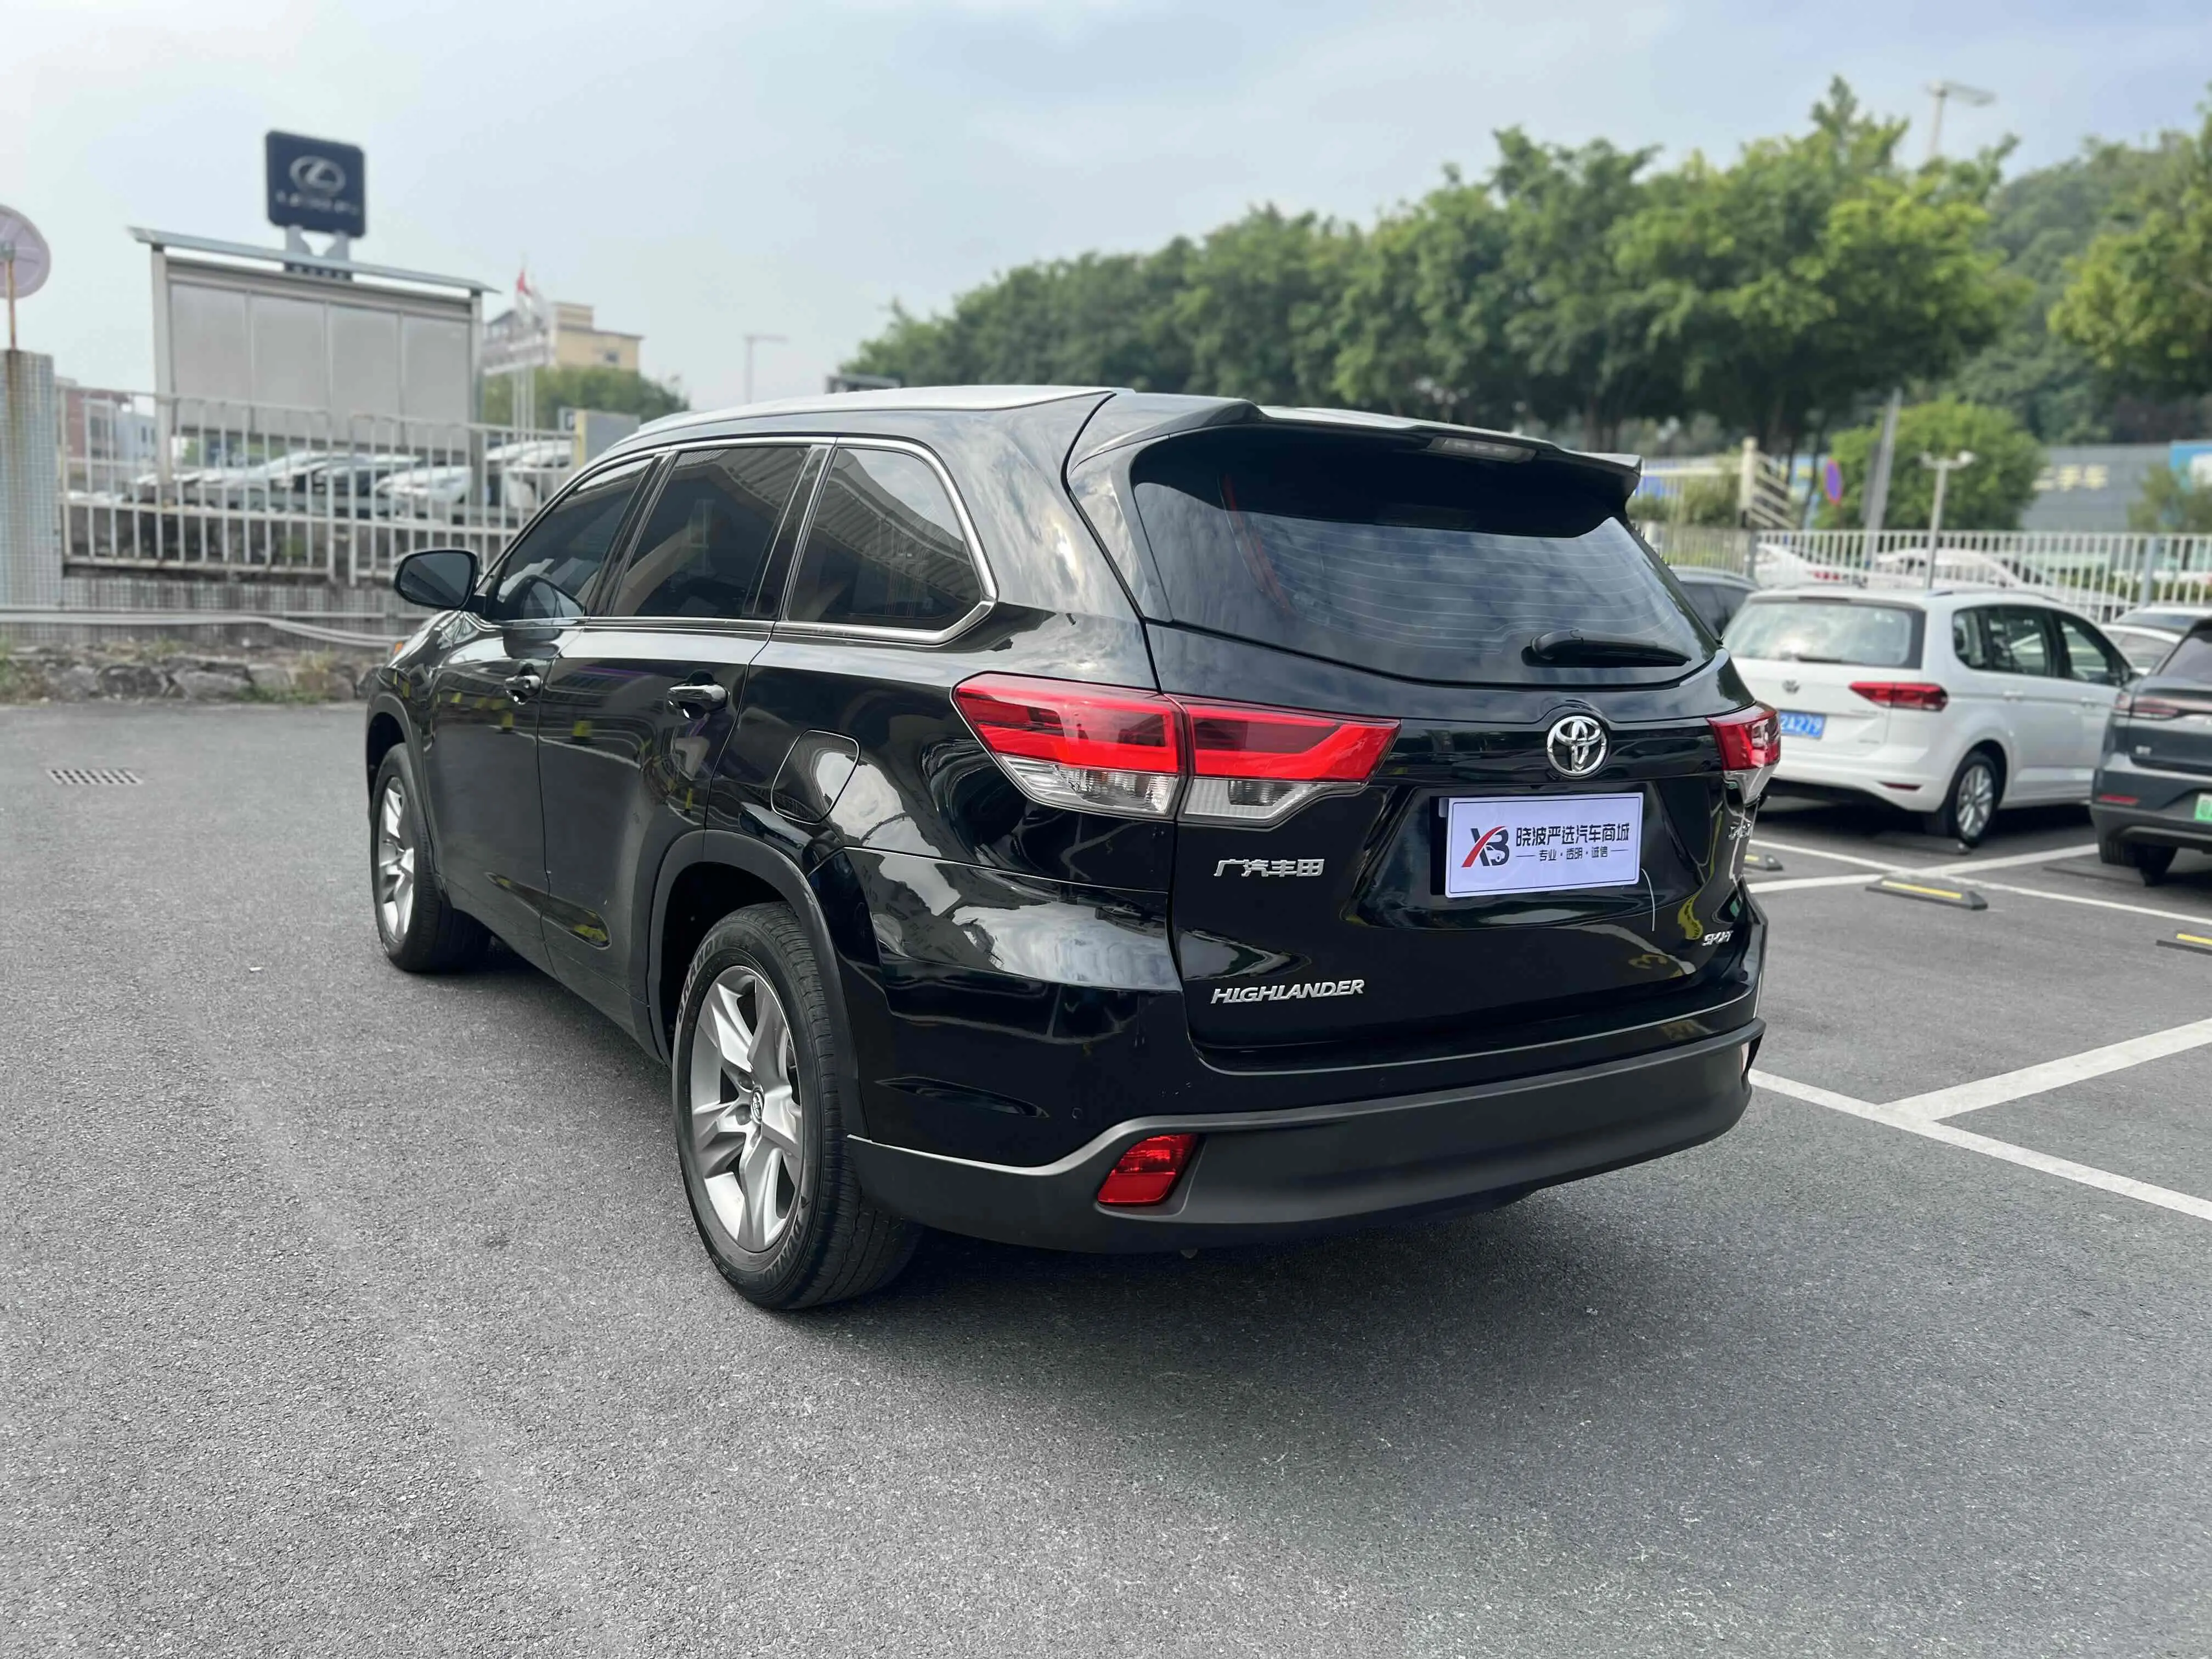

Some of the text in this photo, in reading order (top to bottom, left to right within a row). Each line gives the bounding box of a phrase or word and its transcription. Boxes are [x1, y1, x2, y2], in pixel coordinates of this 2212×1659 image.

[1516, 823, 1630, 847] 晓波严选汽车商城
[1214, 859, 1325, 877] 广汽丰田
[1210, 979, 1365, 1004] HIGHLANDER
